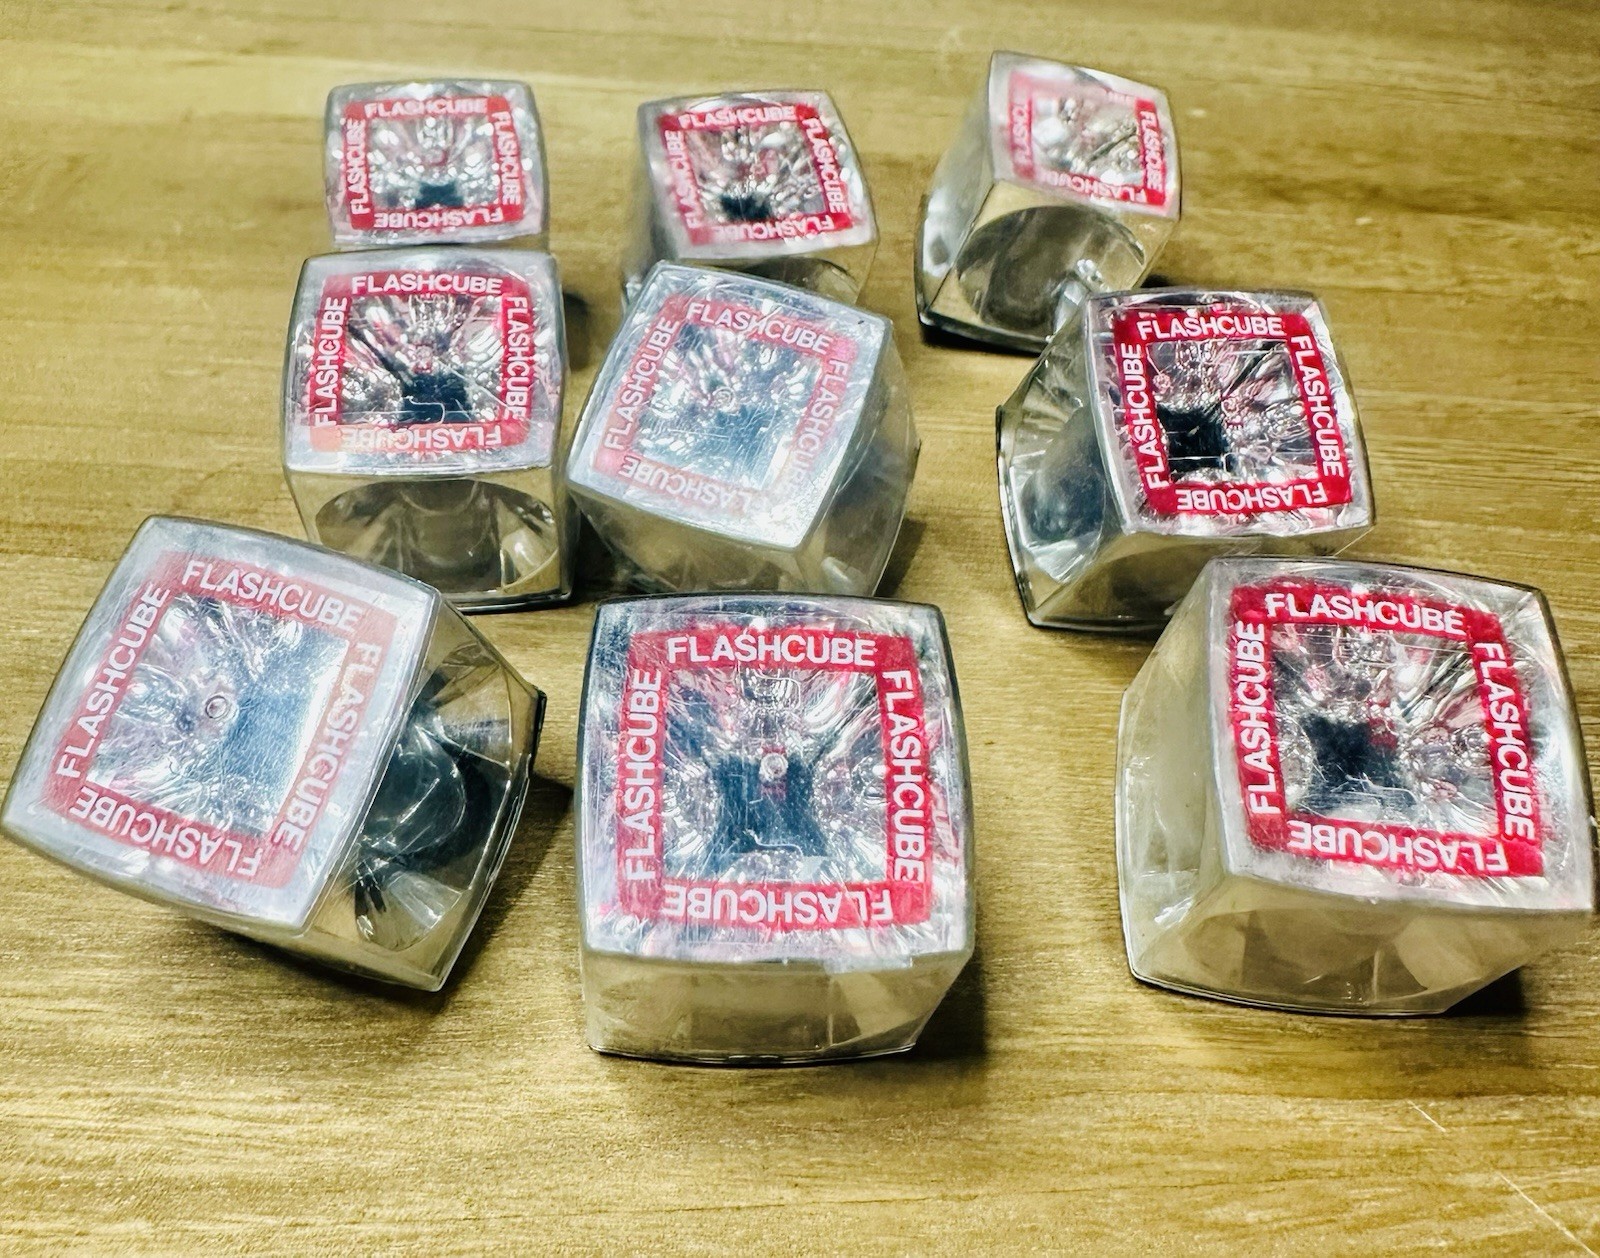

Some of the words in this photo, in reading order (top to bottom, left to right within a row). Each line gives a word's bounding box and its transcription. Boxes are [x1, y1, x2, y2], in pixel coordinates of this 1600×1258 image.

[364, 99, 488, 118] FLASHCUBE
[678, 106, 799, 129] FLASHCUBE
[346, 118, 371, 215] FLASHCUBE
[491, 111, 521, 206] FLASHCUBE
[802, 118, 849, 214] FLASHCUBE
[373, 207, 504, 228] FLASHCUBE
[714, 215, 834, 240] FLASHCUBE
[351, 273, 502, 294] FLASHCUBE
[314, 297, 348, 427] FLASHCUBE
[505, 296, 528, 421] FLASHCUBE
[686, 303, 833, 355] FLASHCUBE
[1137, 316, 1285, 340] FLASHCUBE
[604, 319, 680, 450] FLASHCUBE
[1121, 343, 1170, 490] FLASHCUBE
[1291, 335, 1344, 478] FLASHCUBE
[344, 427, 501, 451] FLASHCUBE
[619, 455, 768, 518] LASHCUBE
[1175, 483, 1328, 511] FLASHCUBE
[181, 561, 364, 633] FLASHCUBE
[1265, 593, 1466, 635] FLASHCUBE
[56, 585, 171, 780] FLASHCUBE
[667, 636, 876, 666] FLASHCUBE
[275, 642, 381, 851] FLASHCUBE
[1235, 621, 1281, 815] FLASHCUBE
[1473, 642, 1536, 842] FLASHCUBE
[625, 668, 662, 882] FLASHCUBE
[882, 669, 926, 882] FLASHCUBE
[69, 786, 264, 878] FLASHCUBE
[1286, 819, 1510, 873] FLASHCUBE
[661, 884, 894, 923] FLASHCUBE
